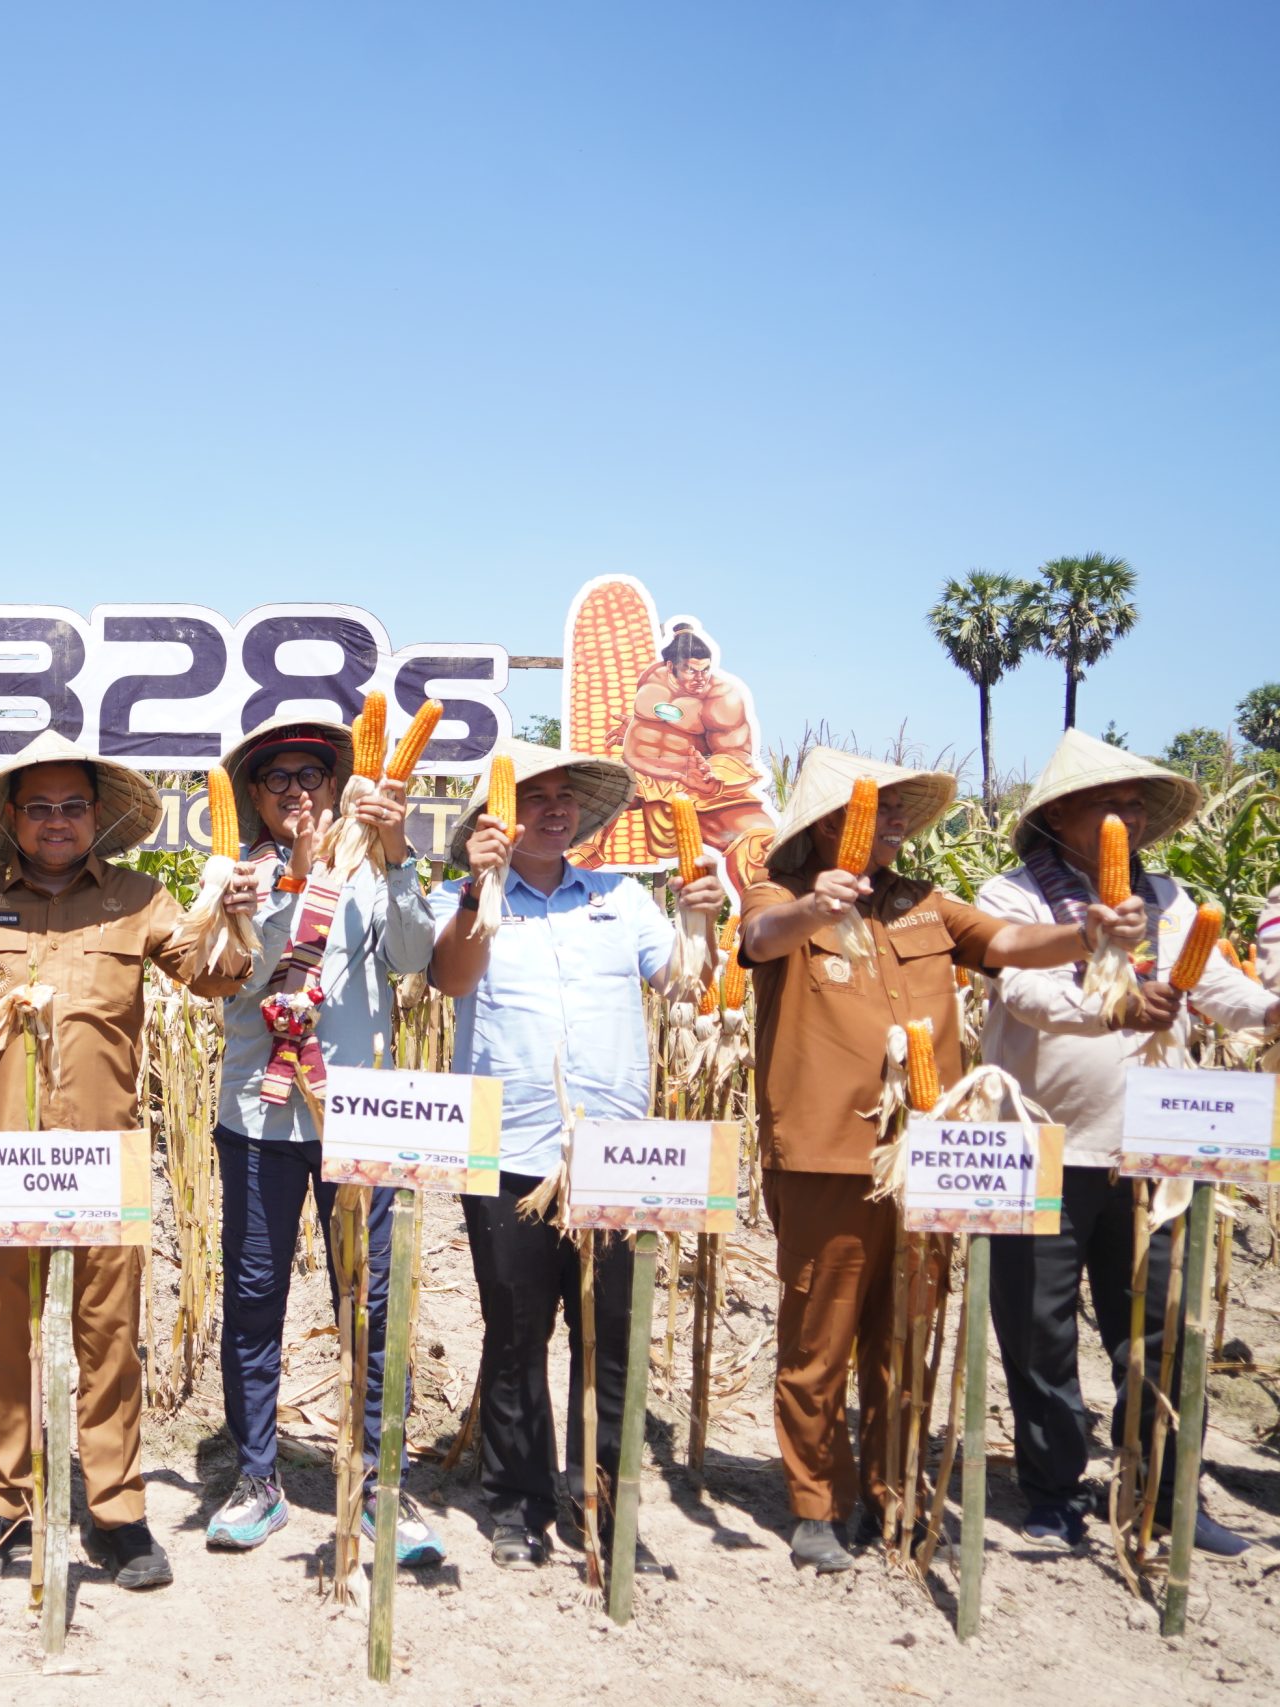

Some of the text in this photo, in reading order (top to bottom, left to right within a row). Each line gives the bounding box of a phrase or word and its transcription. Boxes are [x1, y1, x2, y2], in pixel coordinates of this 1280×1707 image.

[917, 910, 939, 924] TPH
[331, 1095, 464, 1123] SYNGENTA
[1161, 1098, 1235, 1113] RETAILER
[940, 1129, 1007, 1147] KADIS
[51, 1147, 111, 1166] BUPATI
[603, 1145, 687, 1166] KAJARI
[910, 1150, 1034, 1170] PERTANIAN
[23, 1172, 79, 1192] GOWA
[937, 1173, 1007, 1191] GOWA
